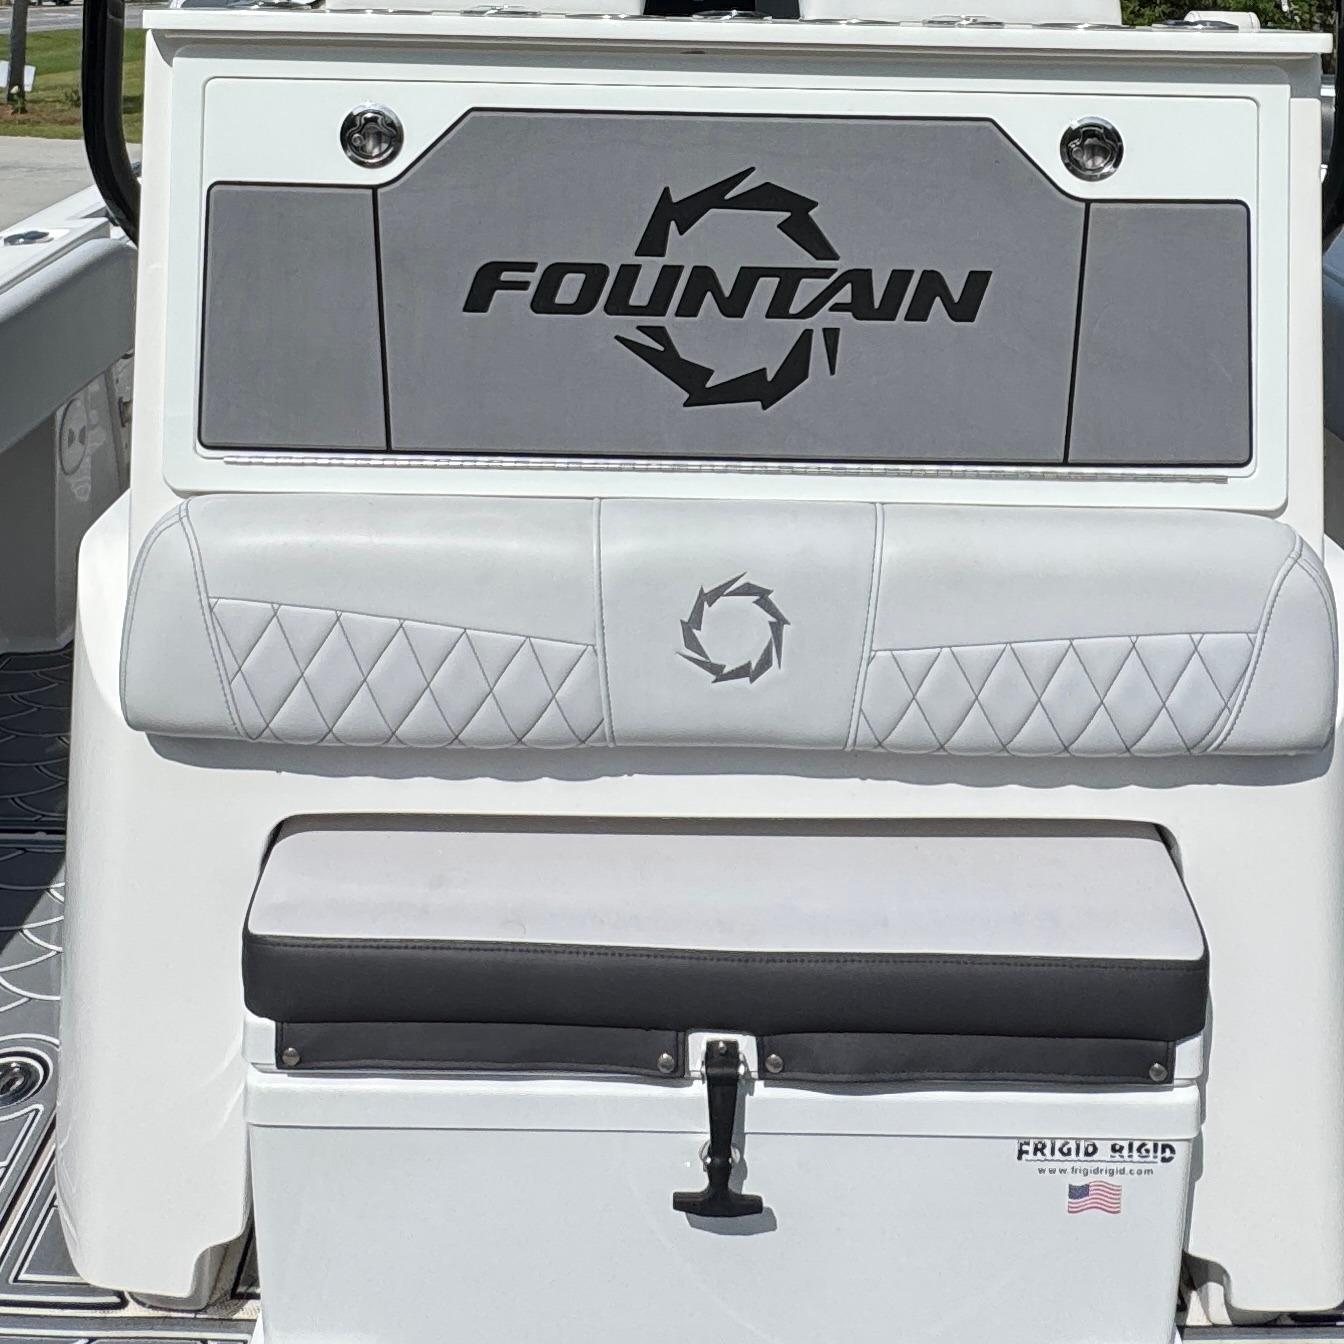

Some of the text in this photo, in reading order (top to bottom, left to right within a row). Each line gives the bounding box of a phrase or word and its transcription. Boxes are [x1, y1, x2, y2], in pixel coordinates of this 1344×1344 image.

[462, 259, 993, 324] FOUNTAIN
[1017, 1140, 1176, 1163] FRIGID RIGID
[1038, 1165, 1154, 1177] www.frigidrigid.com
